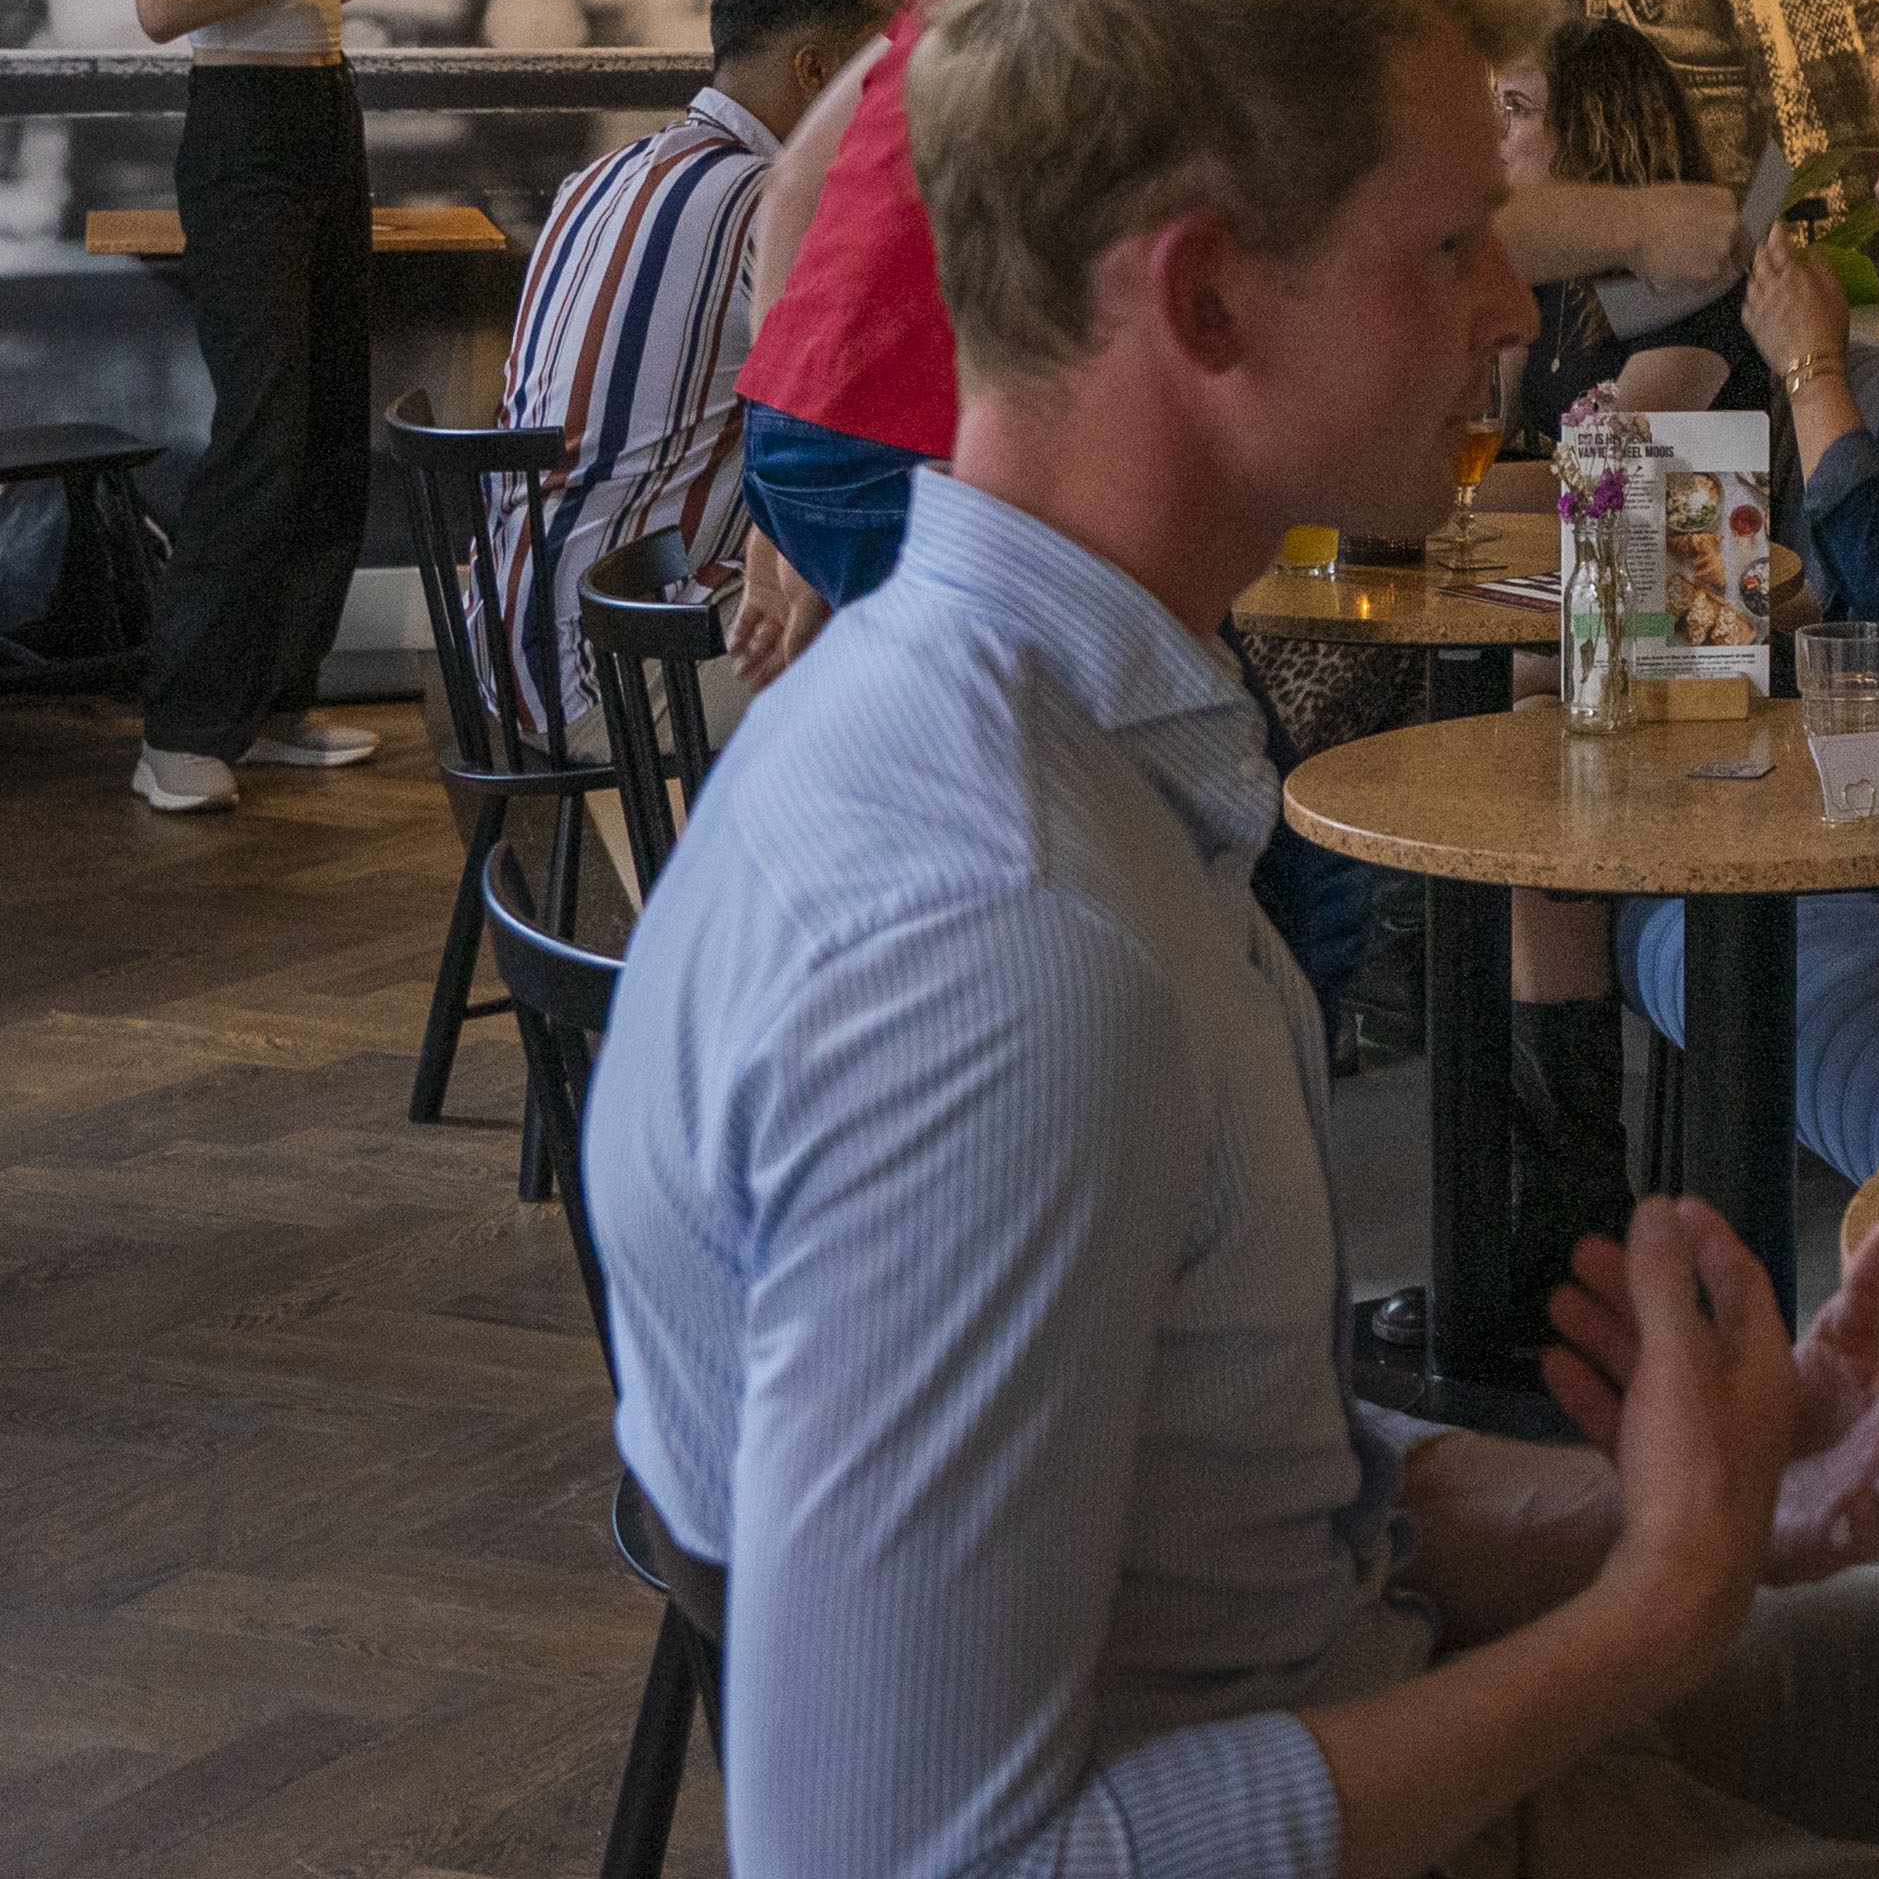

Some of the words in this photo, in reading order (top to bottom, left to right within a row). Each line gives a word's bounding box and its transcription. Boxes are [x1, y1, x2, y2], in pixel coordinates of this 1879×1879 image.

[1595, 433, 1604, 446] IS
[1577, 446, 1596, 459] VAN
[1645, 445, 1675, 458] MOOIS
